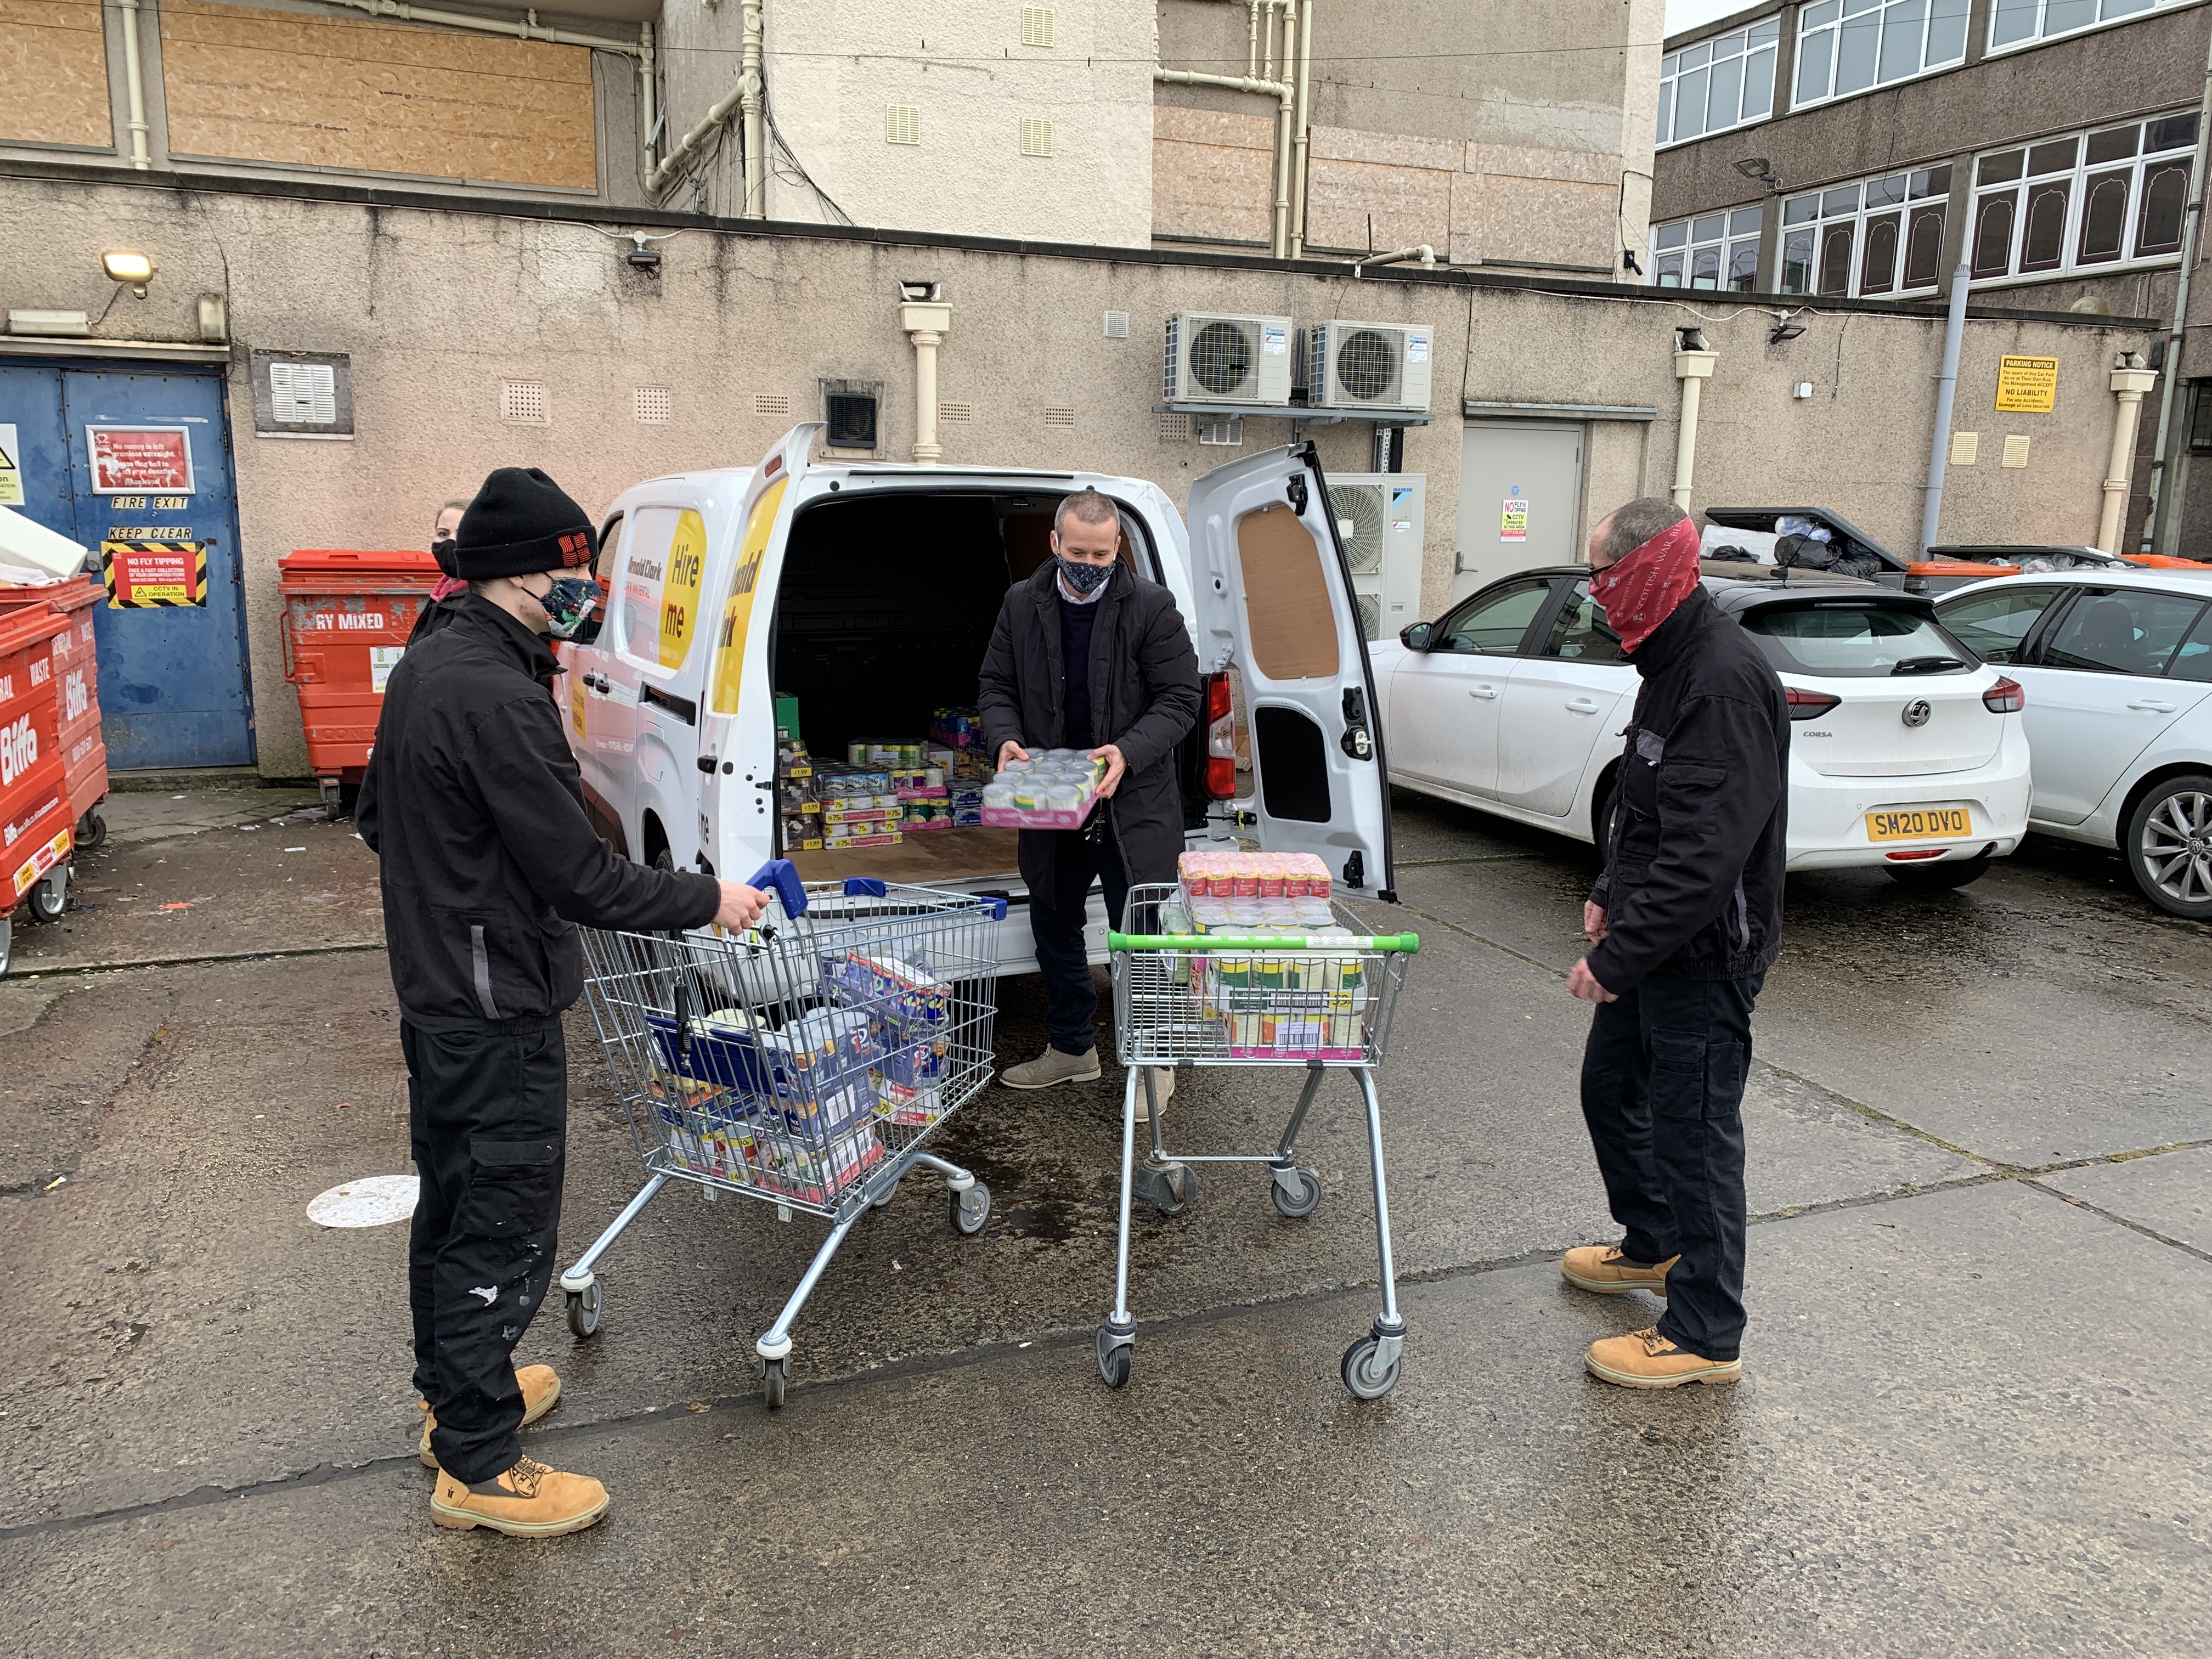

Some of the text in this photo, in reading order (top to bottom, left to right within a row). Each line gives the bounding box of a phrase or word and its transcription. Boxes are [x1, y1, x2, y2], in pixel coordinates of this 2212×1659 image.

[2006, 359, 2032, 368] PARKING
[112, 497, 187, 509] FIRE EXIT
[1504, 502, 1514, 512] NO
[109, 528, 191, 539] KEEP CLEAR
[139, 557, 154, 566] FLY
[154, 557, 184, 566] TIPPING
[627, 555, 662, 582] Arnold Clark
[672, 543, 699, 588] Hire
[1637, 567, 1661, 610] SCOTTISH
[1655, 540, 1673, 563] WAR
[337, 613, 383, 629] MIXED
[665, 603, 685, 639] me
[29, 658, 50, 687] WASTE
[0, 712, 38, 786] Biffa
[1875, 811, 1963, 835] SM20 DVO
[881, 1103, 890, 1114] 75
